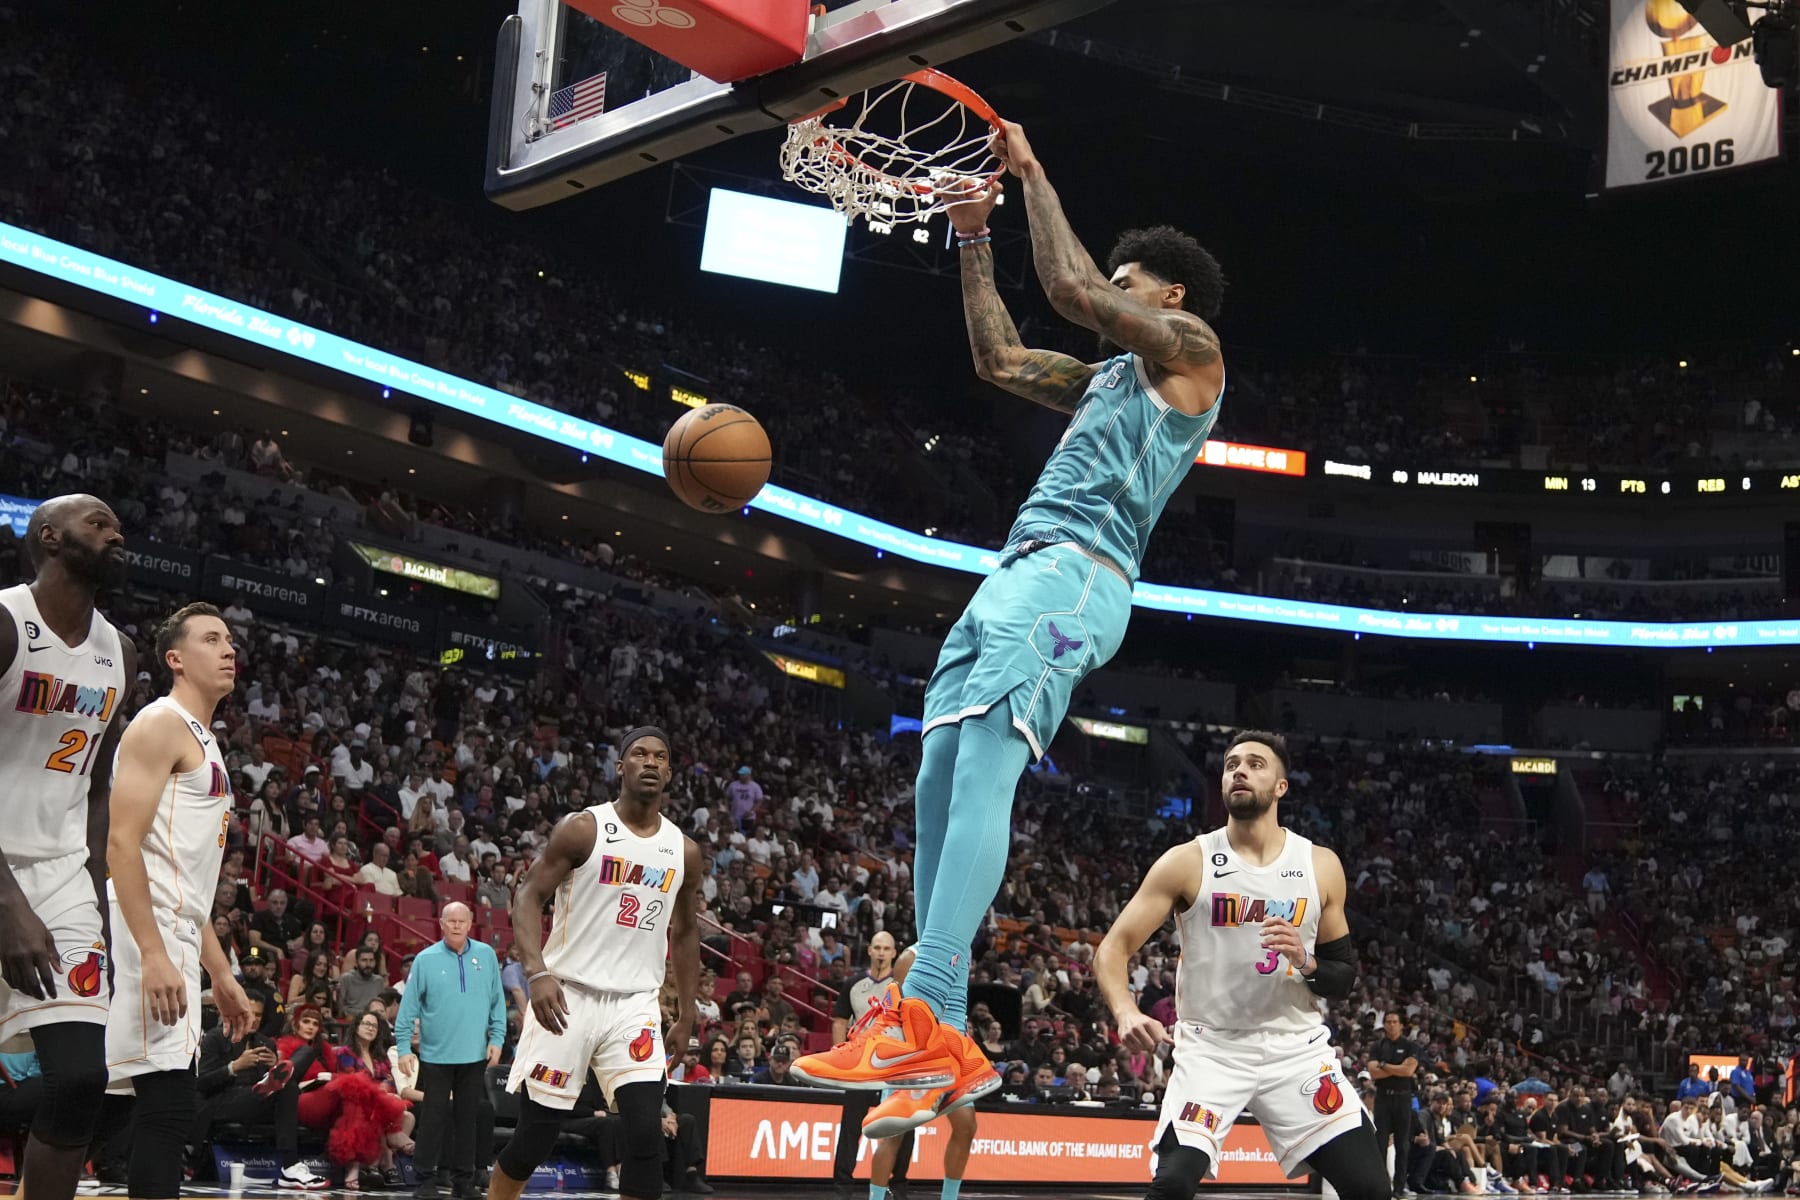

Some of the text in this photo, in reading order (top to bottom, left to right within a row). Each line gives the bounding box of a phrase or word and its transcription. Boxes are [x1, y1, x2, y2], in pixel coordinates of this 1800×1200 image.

[1645, 139, 1735, 180] 2006
[181, 294, 282, 339] Florida Blue
[507, 404, 587, 441] Florida Blue
[1417, 471, 1479, 486] MALEDON
[1545, 477, 1568, 490] MIN
[1581, 478, 1596, 491] 13
[1620, 480, 1646, 493] PTS
[1698, 479, 1726, 492] REB
[143, 554, 191, 577] arena
[263, 586, 307, 606] arena
[25, 621, 38, 639] 6
[379, 612, 420, 633] arena
[94, 655, 113, 668] UKG
[15, 670, 117, 722] MIAMI
[658, 847, 674, 856] UKG
[1215, 854, 1225, 866] 6
[599, 854, 676, 893] MIAMI
[1280, 870, 1304, 878] UKG
[616, 893, 664, 932] 22
[1211, 892, 1308, 928] MIAMI
[530, 1063, 572, 1089] HEAT
[1179, 1101, 1223, 1134] HEAT
[970, 1138, 1143, 1160] OFFICIAL BANK OF THE MIAMI HEAT
